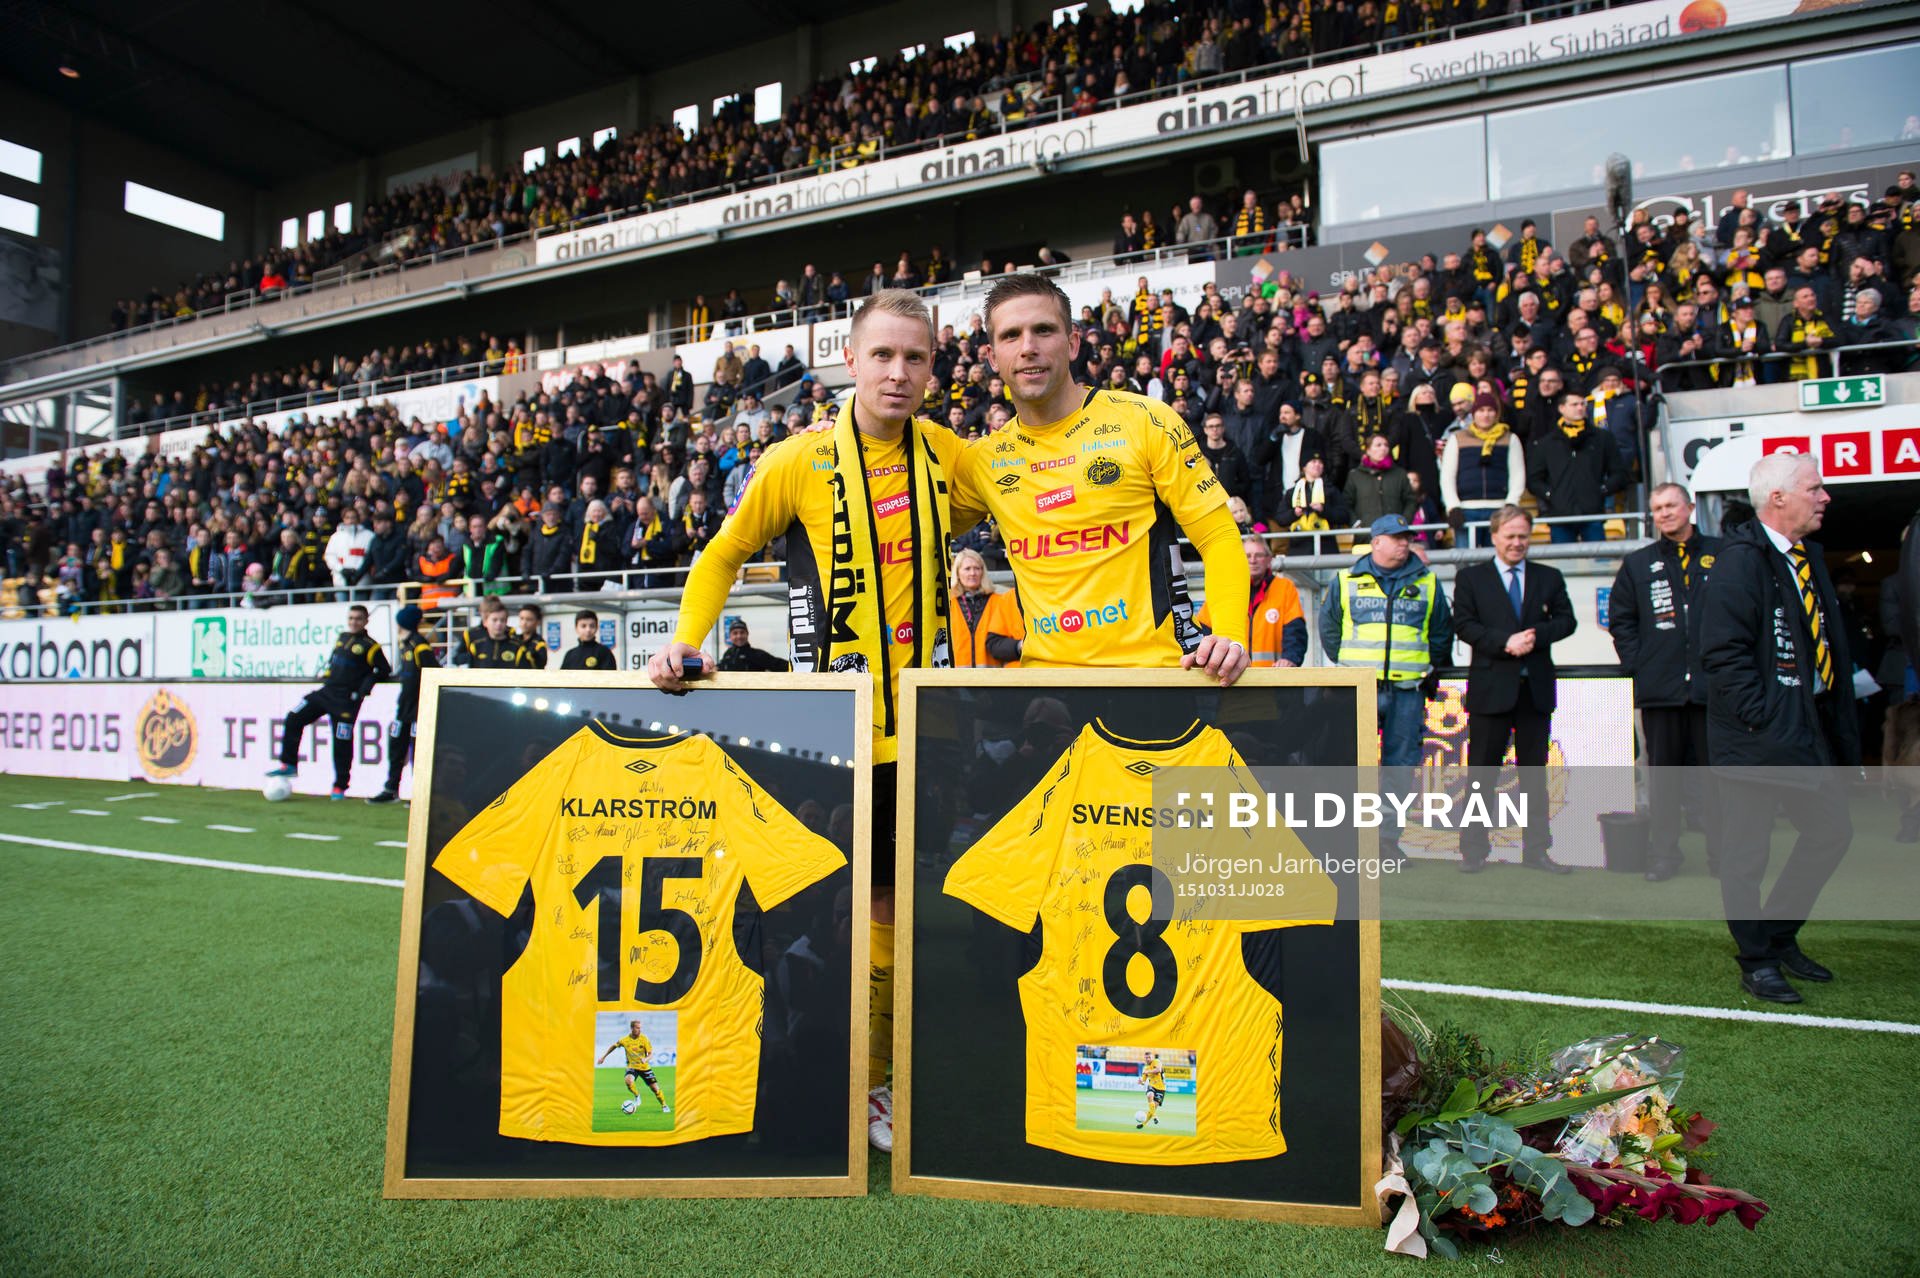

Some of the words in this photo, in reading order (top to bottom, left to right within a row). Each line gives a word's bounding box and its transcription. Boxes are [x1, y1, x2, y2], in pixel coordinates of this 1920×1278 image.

[1409, 41, 1542, 84] Swedbank
[1094, 423, 1121, 436] ellos
[816, 445, 835, 456] ello
[996, 441, 1016, 453] ellos
[1081, 439, 1126, 453] Folksam
[1031, 455, 1076, 473] CRAMO
[1000, 486, 1020, 496] umbro
[1037, 489, 1073, 508] STAPLES
[876, 495, 911, 514] STAPLES
[1009, 520, 1130, 560] PULSEN
[52, 713, 120, 752] 2015
[223, 717, 257, 759] IF
[560, 797, 717, 819] KLARSTRÖM
[1072, 804, 1214, 829] SVENSSON
[572, 855, 704, 1005] 15
[1102, 863, 1178, 1019] 8
